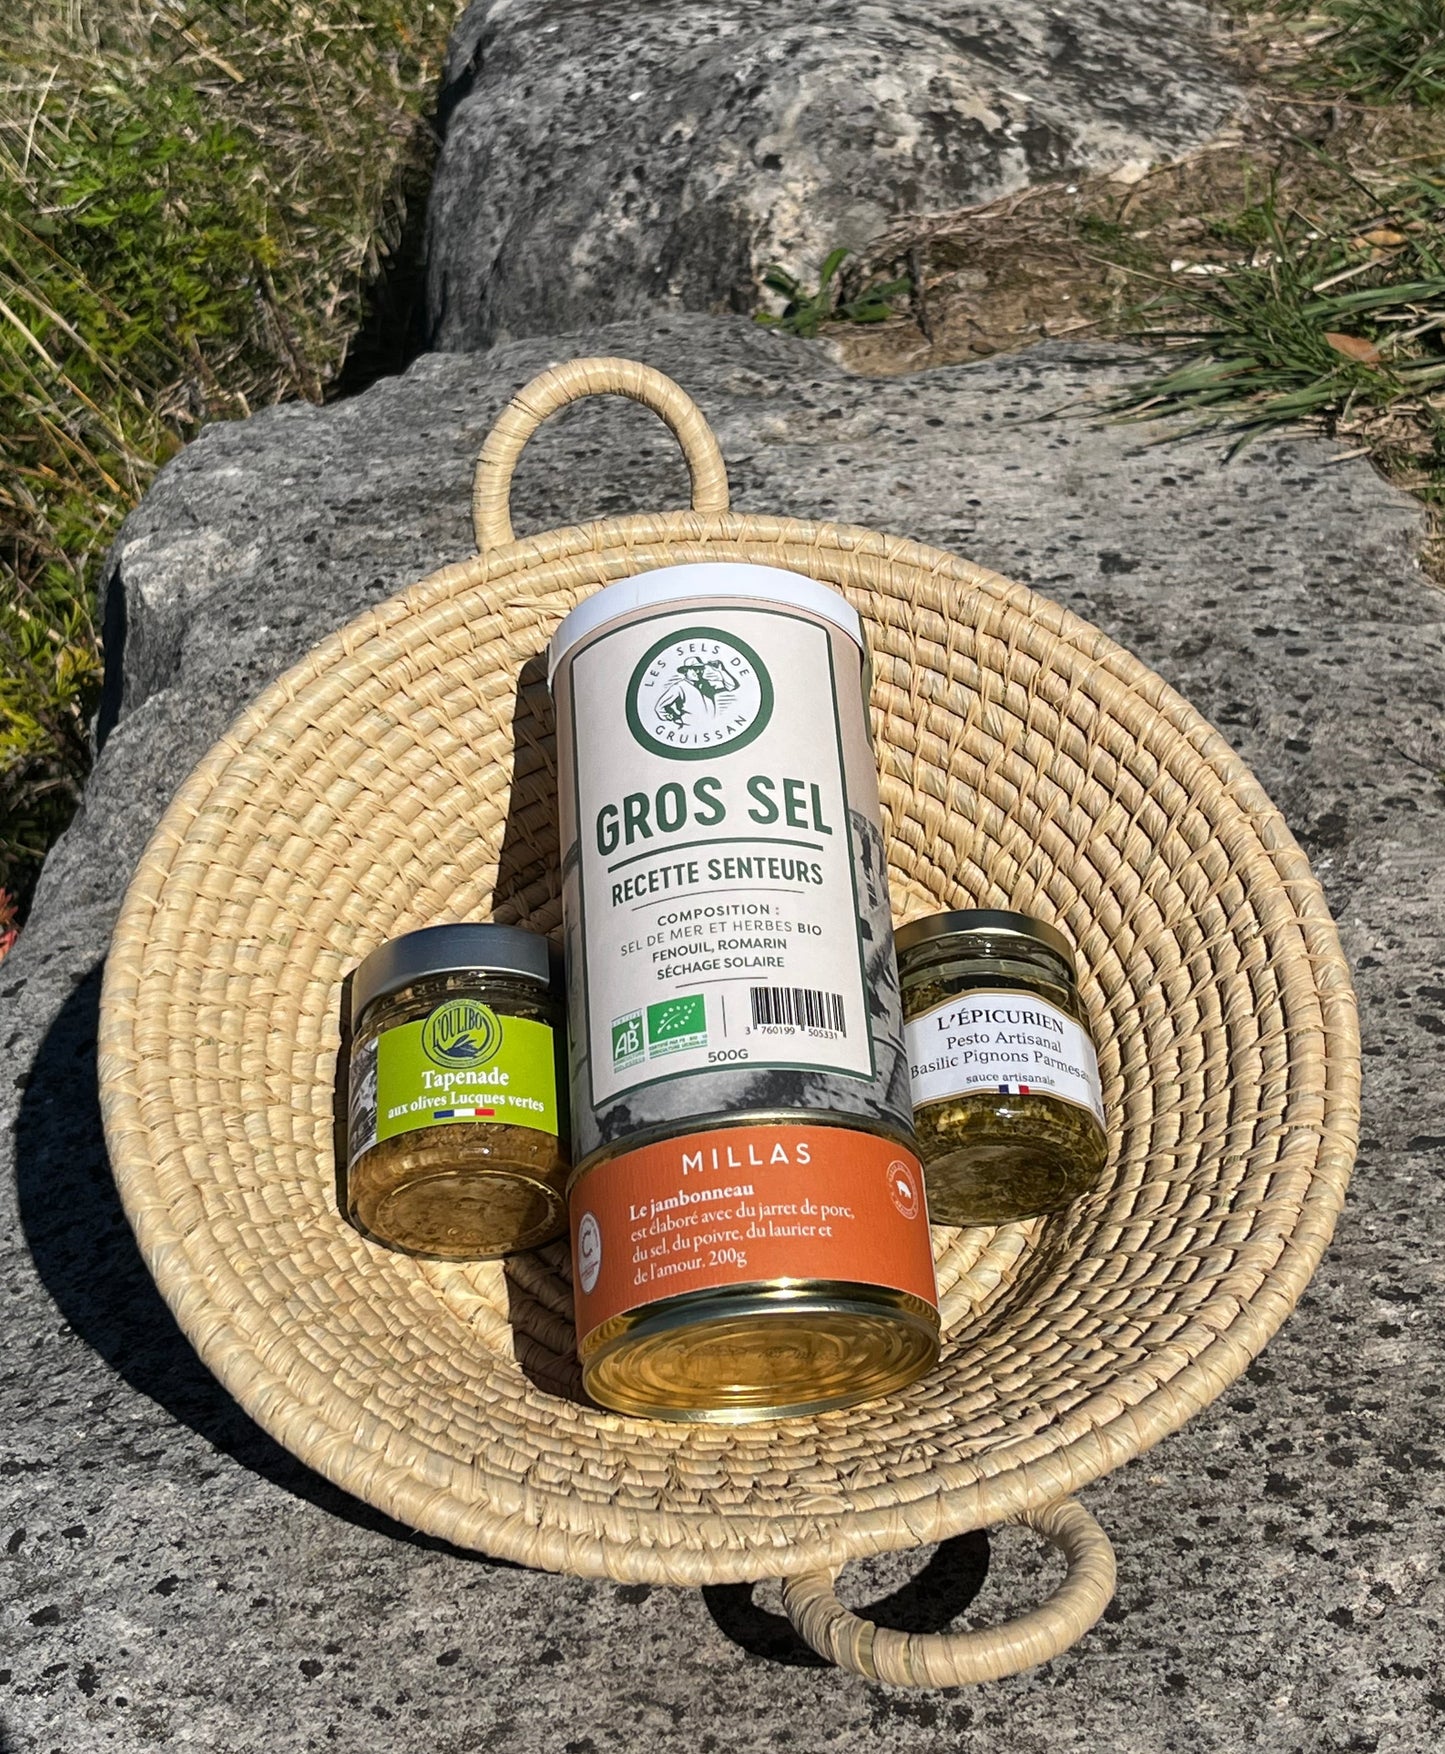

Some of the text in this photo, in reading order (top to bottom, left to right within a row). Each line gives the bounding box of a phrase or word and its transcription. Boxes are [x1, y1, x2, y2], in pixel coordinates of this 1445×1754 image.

[645, 643, 750, 687] LES SELS DE
[656, 715, 747, 743] GRUISSAN
[596, 775, 833, 856] GROS SEL
[612, 857, 823, 907] RECETTE SENTEURS
[658, 904, 770, 926] COMPOSITION
[621, 920, 822, 956] SEL DE MER ET HERBES BIO
[652, 938, 787, 963] FENOUIL, ROMARIN
[657, 956, 784, 980] SÉCHAGE SOLAIRE
[745, 1026, 838, 1040] 3 760199 505331
[937, 1008, 1064, 1034] L'ÉPICURIEN
[708, 1049, 749, 1062] 500G
[947, 1032, 1062, 1053] Pesto Artisanal
[422, 1067, 509, 1091] Tapenade
[911, 1055, 959, 1080] Basilic
[964, 1050, 1028, 1064] Pignons
[966, 1073, 1055, 1086] sauce artisanale
[388, 1091, 544, 1119] aux olives Lucques vertes
[682, 1143, 811, 1176] MILLAS
[629, 1184, 754, 1221] Le jambonneau
[631, 1199, 855, 1242] est élaboré avec du jarret de porc,
[632, 1222, 832, 1263] du sel, du poivre, du laurier et
[633, 1251, 746, 1286] de l'amour. 200g
